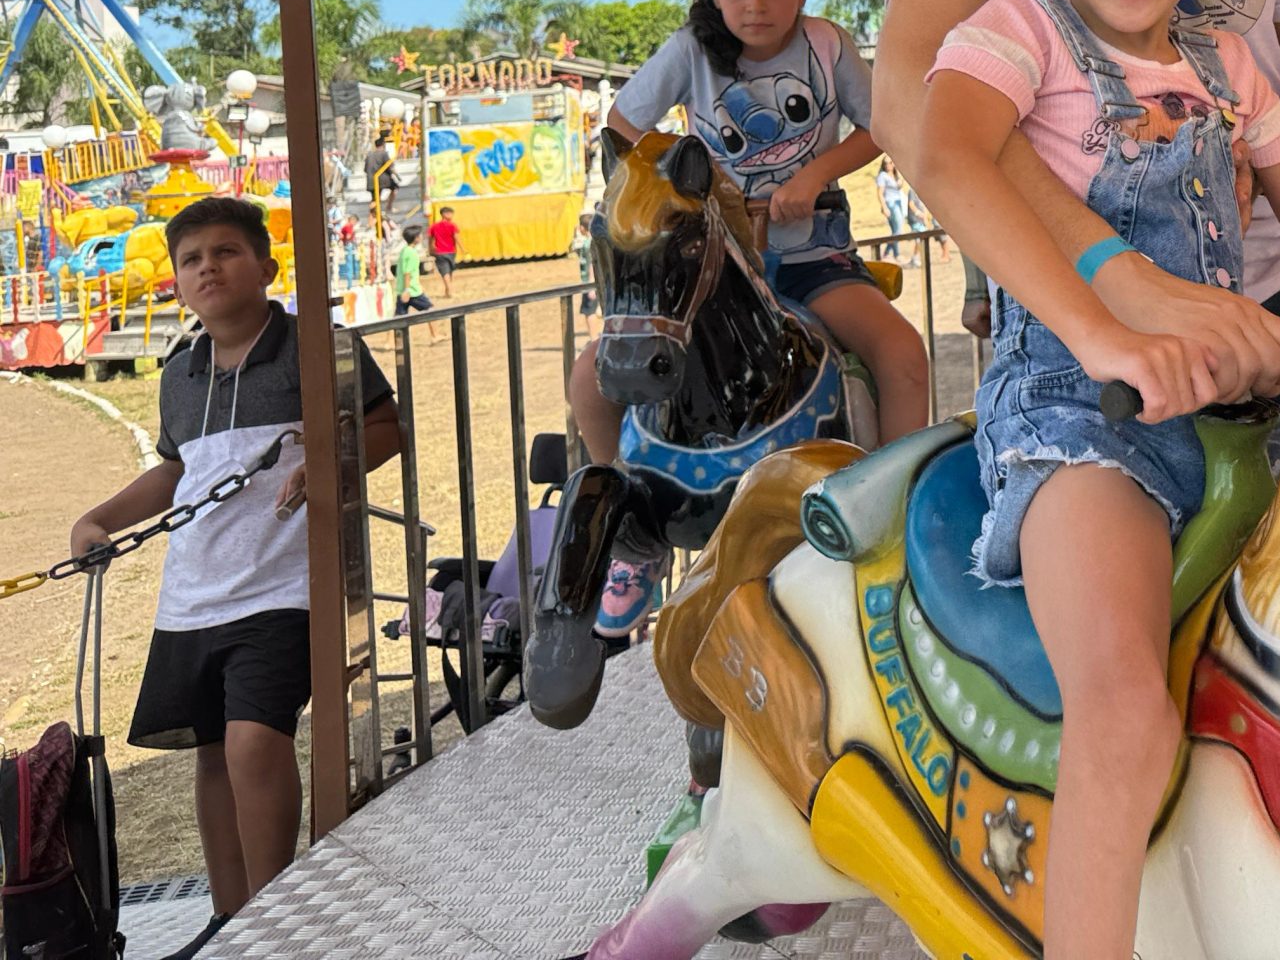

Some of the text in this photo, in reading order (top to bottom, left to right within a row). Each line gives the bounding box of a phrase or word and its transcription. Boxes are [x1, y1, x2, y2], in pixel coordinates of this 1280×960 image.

[420, 58, 553, 93] TORNADO
[476, 138, 525, 178] RAP
[864, 585, 952, 797] BUFFALO
